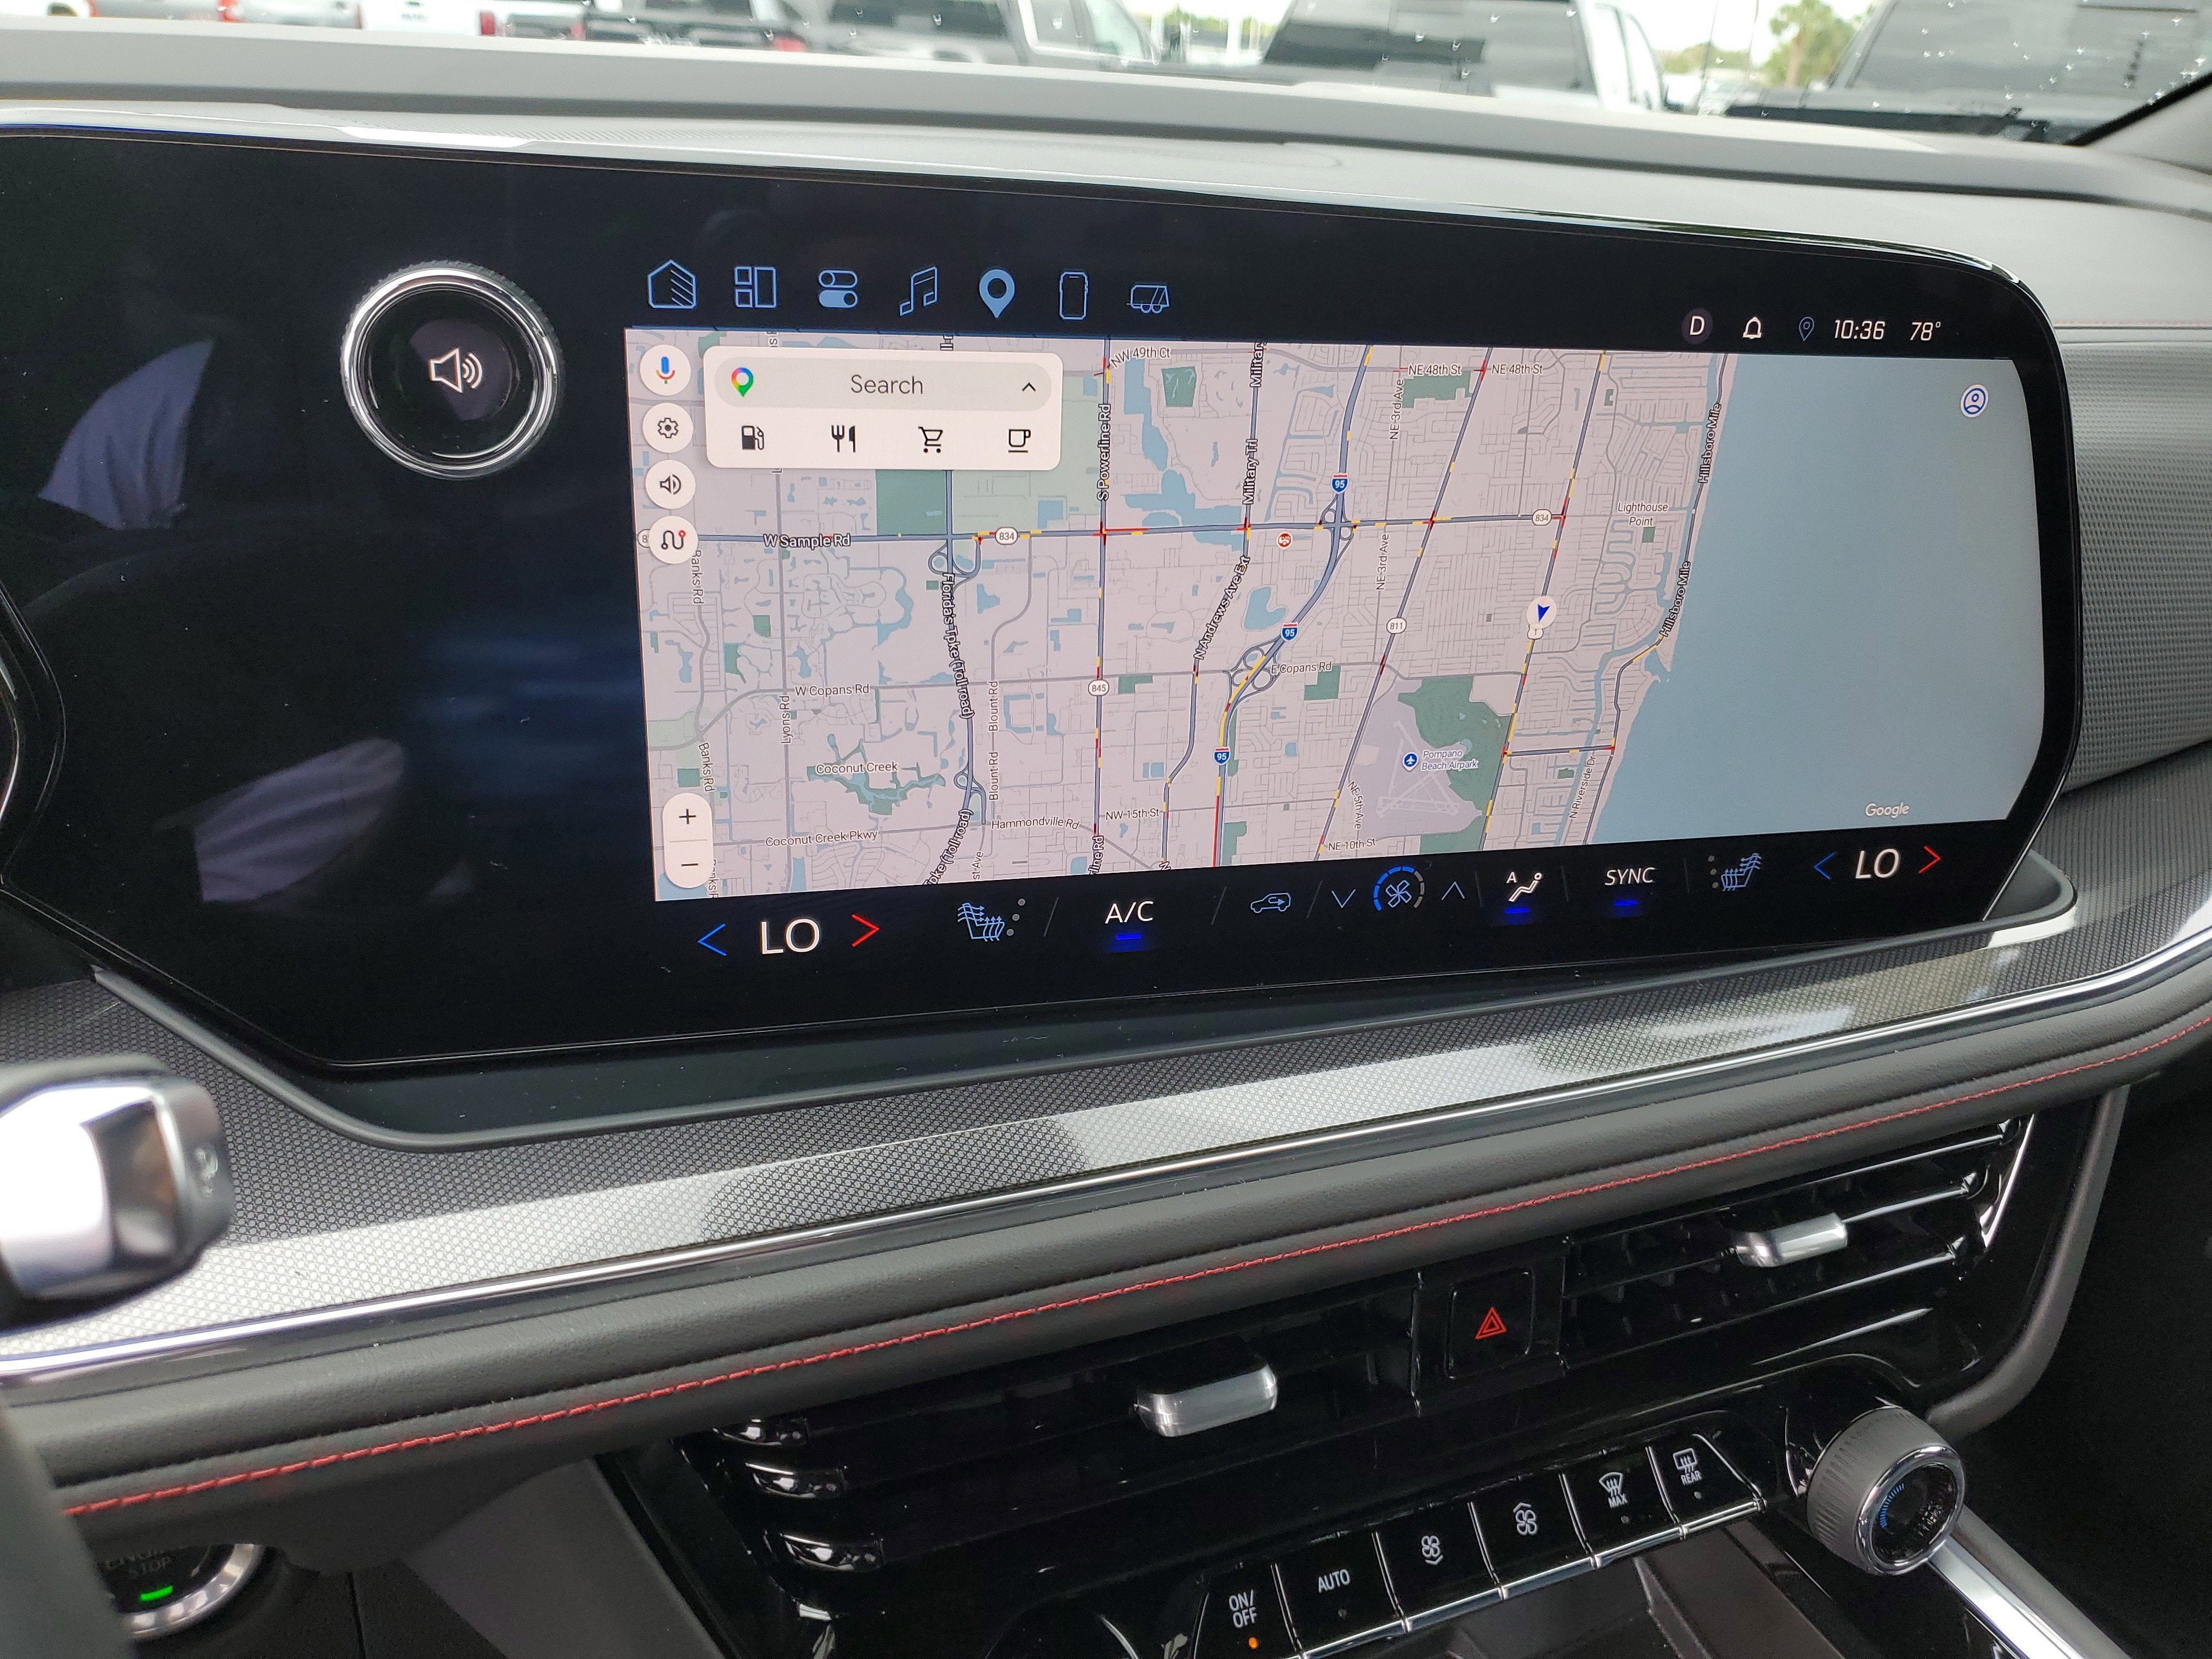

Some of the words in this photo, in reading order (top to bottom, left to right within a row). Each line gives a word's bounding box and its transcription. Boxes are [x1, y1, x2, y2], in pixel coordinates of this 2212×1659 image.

[1690, 316, 1705, 335] D
[1834, 320, 1885, 340] 10:36
[1910, 321, 1940, 340] 78°
[1111, 348, 1129, 368] NW
[1133, 347, 1156, 358] 49th
[1160, 347, 1170, 358] Ct
[1409, 365, 1425, 376] NE
[1426, 364, 1447, 375] 48th
[1449, 364, 1461, 375] St
[1492, 364, 1506, 375] NE
[1509, 364, 1530, 375] 48th
[1532, 364, 1543, 375] St
[850, 374, 923, 395] Search
[1393, 379, 1403, 399] Ave
[1098, 403, 1111, 421] Rd
[1391, 403, 1402, 420] 3rd
[1706, 403, 1722, 428] Mile
[1390, 424, 1400, 439] NE
[1245, 439, 1258, 455] Trl
[1097, 424, 1110, 489] Powerline
[1699, 431, 1716, 483] Hillsboro
[1242, 457, 1260, 505] Military
[1334, 479, 1345, 489] 95
[1097, 491, 1109, 501] S
[1617, 502, 1668, 514] Lighthouse
[1534, 513, 1549, 522] 834
[1629, 516, 1653, 527] Point
[763, 534, 778, 548] W
[779, 535, 831, 549] Sample
[833, 534, 851, 547] Rd
[999, 532, 1014, 540] 834
[1379, 534, 1389, 553] Ave
[1234, 555, 1250, 575] Ext
[1378, 556, 1387, 572] 3rd
[1224, 575, 1242, 599] Ave
[1376, 575, 1385, 590] NE
[693, 589, 704, 604] Rd
[941, 572, 957, 625] Florida's
[1659, 588, 1685, 637] Hillsboro
[1677, 561, 1691, 585] Mile
[1199, 599, 1230, 650] Andrews
[1285, 628, 1295, 637] 95
[1390, 621, 1403, 630] 811
[944, 625, 961, 658] Tpke
[1193, 648, 1206, 659] N
[949, 659, 968, 686] (Toll
[1271, 665, 1278, 674] E
[1280, 663, 1317, 675] Copans
[1319, 662, 1331, 672] Rd
[795, 686, 808, 696] W
[809, 685, 853, 698] Copans
[855, 684, 869, 694] Rd
[988, 681, 998, 695] Rd
[1091, 684, 1107, 693] 845
[779, 696, 790, 709] Rd
[957, 686, 975, 719] road)
[988, 698, 998, 731] Blount
[781, 713, 794, 743] Lyons
[699, 742, 713, 775] Banks
[989, 751, 999, 765] Rd
[1216, 752, 1227, 761] 95
[1423, 749, 1463, 760] Pompano
[816, 764, 865, 775] Coconut
[867, 761, 898, 772] Creek
[1421, 761, 1446, 771] Beach
[1448, 759, 1478, 770] Airpark
[704, 777, 715, 792] Rd
[989, 768, 999, 801] Blount
[1348, 781, 1361, 795] NE
[1572, 768, 1592, 809] Riverside
[1587, 755, 1596, 766] Dr
[1354, 795, 1364, 811] 5th
[1865, 802, 1909, 819] Google
[1106, 810, 1124, 821] NW
[1126, 808, 1147, 819] 15th
[1149, 807, 1160, 817] St
[1355, 812, 1364, 829] Ave
[992, 817, 1064, 829] Hammondville
[1066, 819, 1080, 830] Rd
[766, 836, 812, 847] Coconut
[815, 832, 847, 843] Creek
[849, 830, 878, 842] Pkwy
[940, 839, 961, 864] (Toll
[954, 809, 974, 839] road)
[1092, 836, 1104, 850] Rd
[1328, 843, 1342, 851] NE
[1345, 840, 1364, 850] 10th
[1367, 838, 1376, 847] St
[972, 851, 984, 869] Ave
[1855, 848, 1900, 879] LO
[1506, 872, 1517, 883] A
[1605, 867, 1656, 885] SYNC
[1105, 901, 1153, 924] A/C
[760, 918, 820, 955] LO
[1680, 1470, 1702, 1486] REAR
[1608, 1493, 1628, 1509] MAX
[1318, 1568, 1351, 1593] AUTO
[1229, 1589, 1254, 1612] ON/
[1233, 1606, 1257, 1628] OFF
